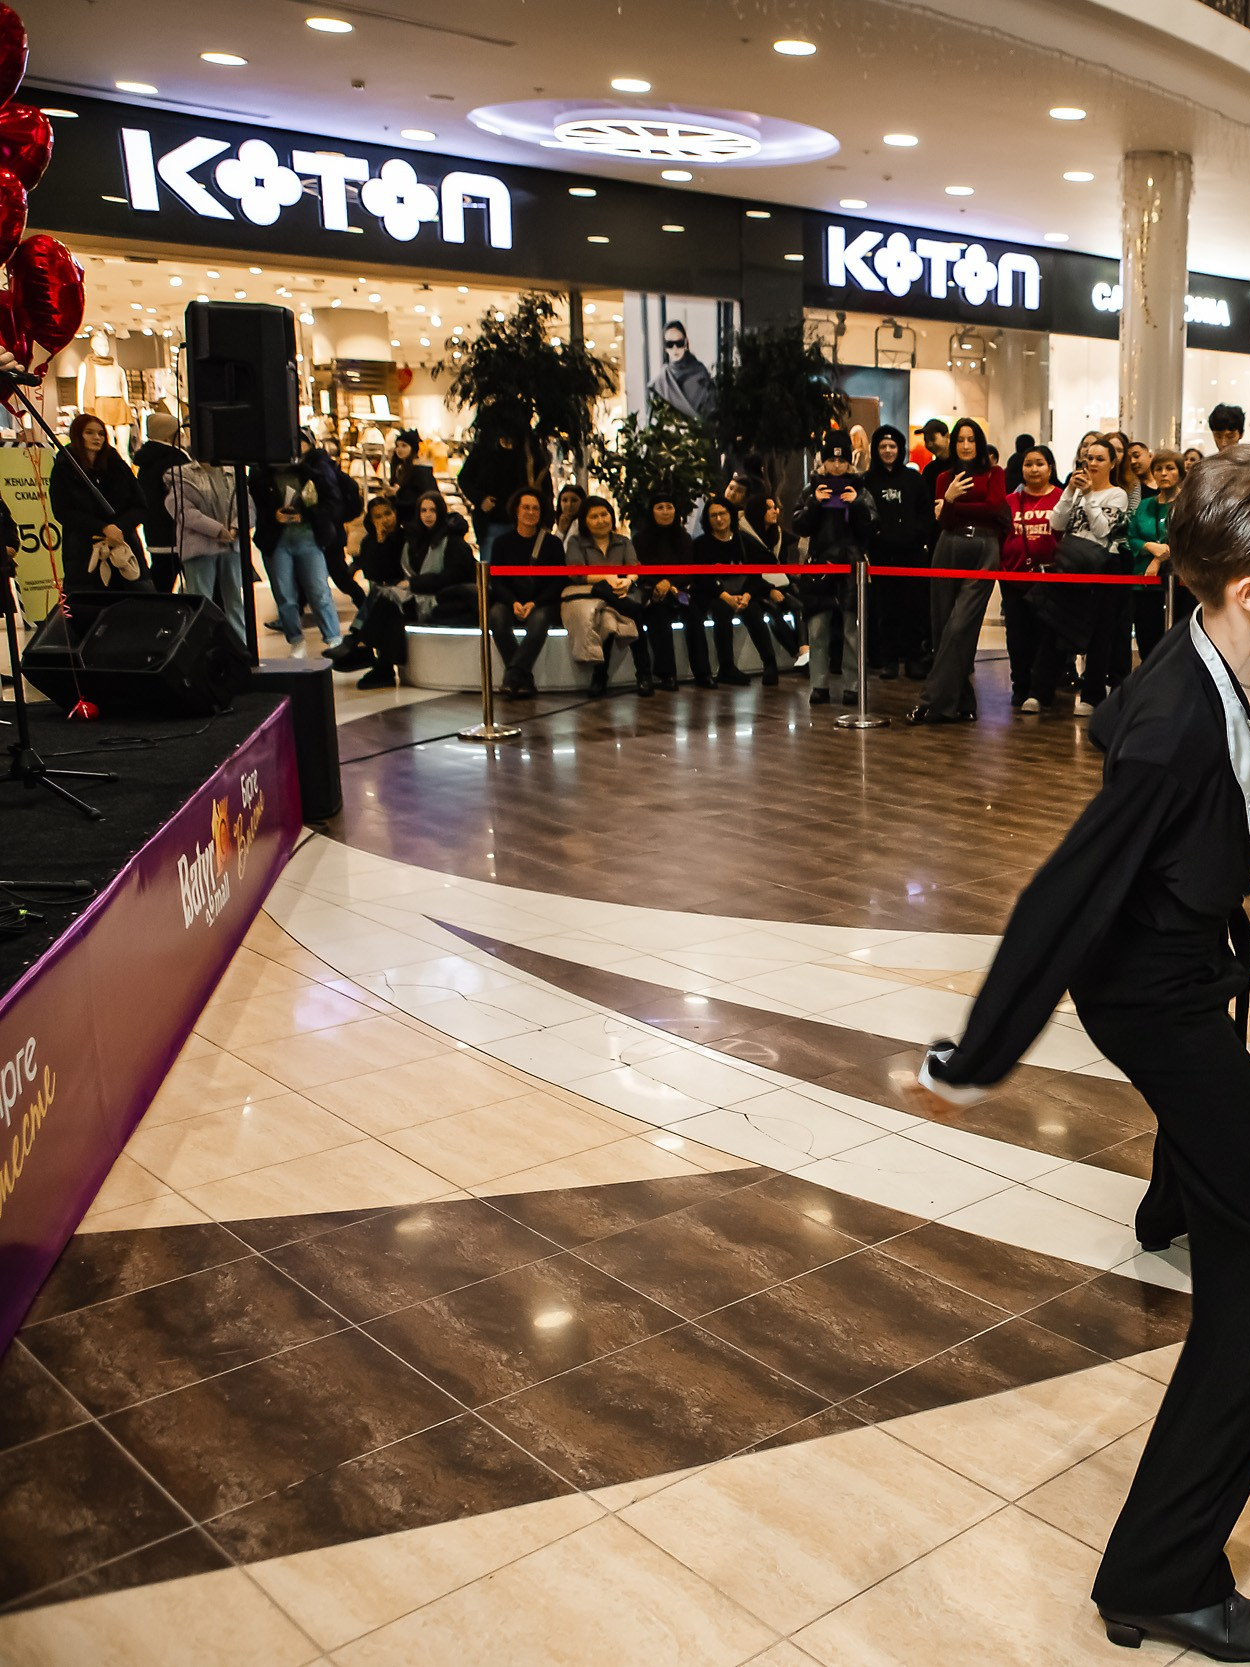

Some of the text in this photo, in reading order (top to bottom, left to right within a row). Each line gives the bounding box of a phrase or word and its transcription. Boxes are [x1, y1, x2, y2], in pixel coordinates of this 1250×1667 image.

[120, 127, 513, 250] KOTON
[827, 225, 1040, 310] KOTON
[18, 522, 62, 553] 50
[177, 840, 217, 929] Batyr
[214, 871, 231, 917] mall
[0, 1065, 56, 1218] месте
